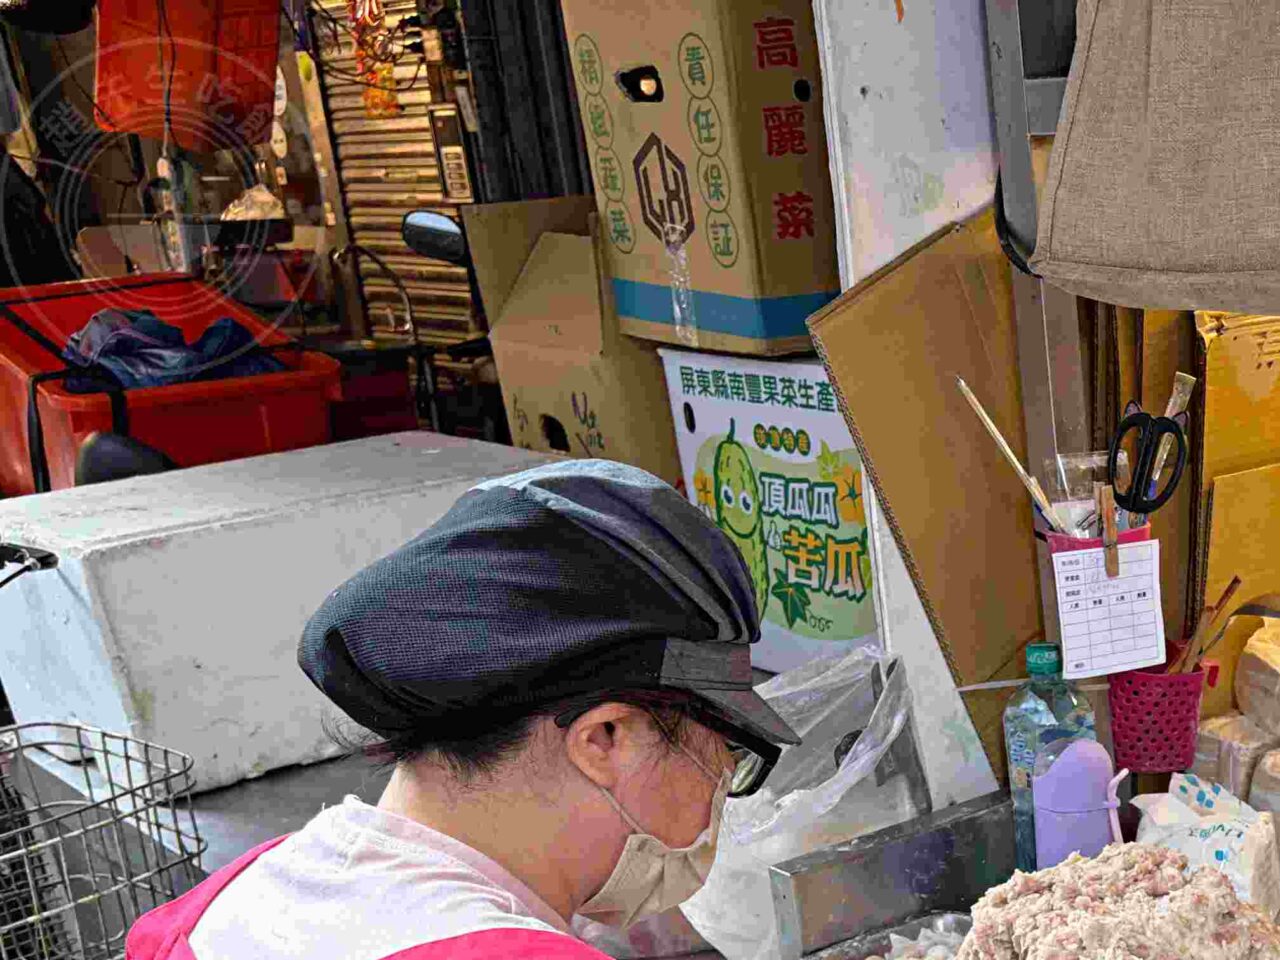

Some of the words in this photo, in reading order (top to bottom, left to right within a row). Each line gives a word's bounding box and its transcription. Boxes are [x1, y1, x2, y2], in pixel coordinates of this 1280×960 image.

[753, 17, 816, 241] 高麗菜
[680, 365, 841, 413] 屏東縣南豐果菜生產
[759, 473, 838, 528] 頂瓜瓜
[782, 525, 867, 604] 苦瓜
